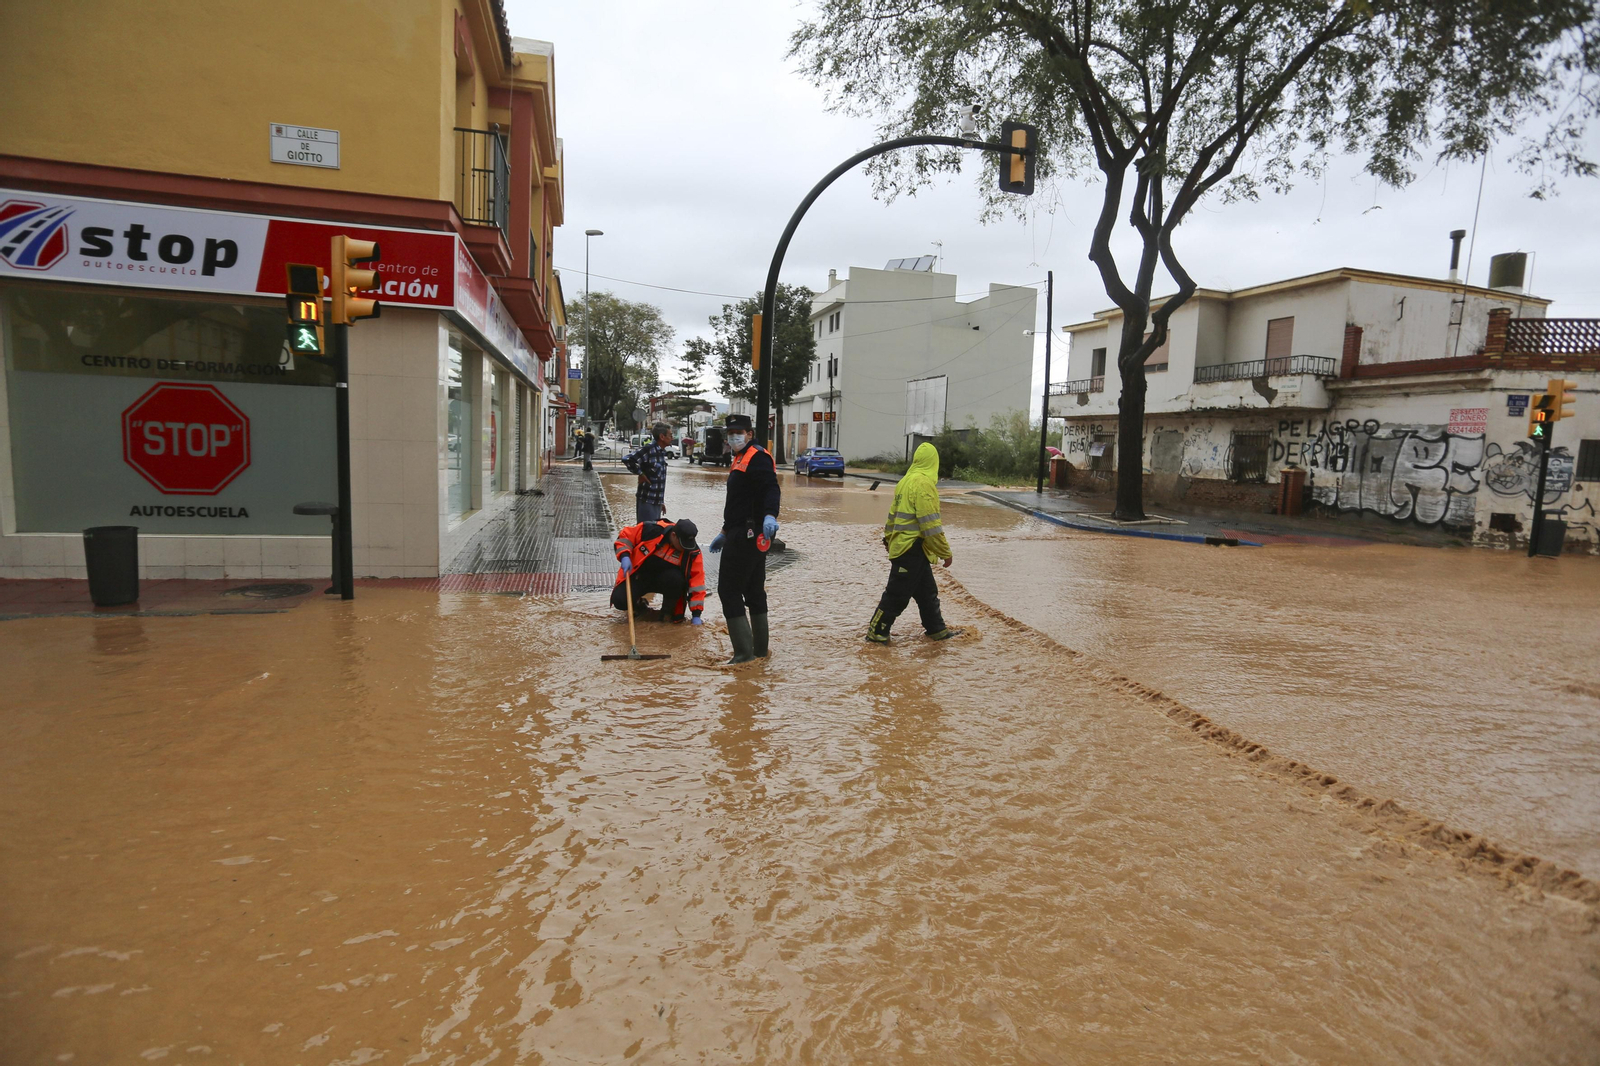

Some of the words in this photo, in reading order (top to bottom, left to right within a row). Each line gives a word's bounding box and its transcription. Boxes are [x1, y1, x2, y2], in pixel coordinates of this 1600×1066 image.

[297, 129, 318, 139] CALLE
[301, 142, 310, 151] DE
[287, 150, 323, 163] GIOTTO
[79, 223, 239, 277] stop
[83, 260, 197, 276] autoescuela
[422, 265, 439, 277] de
[81, 354, 151, 370] CENTRO
[157, 358, 180, 371] DE
[184, 359, 287, 377] FORMACIÓN
[129, 505, 250, 518] AUTOESCUELA
